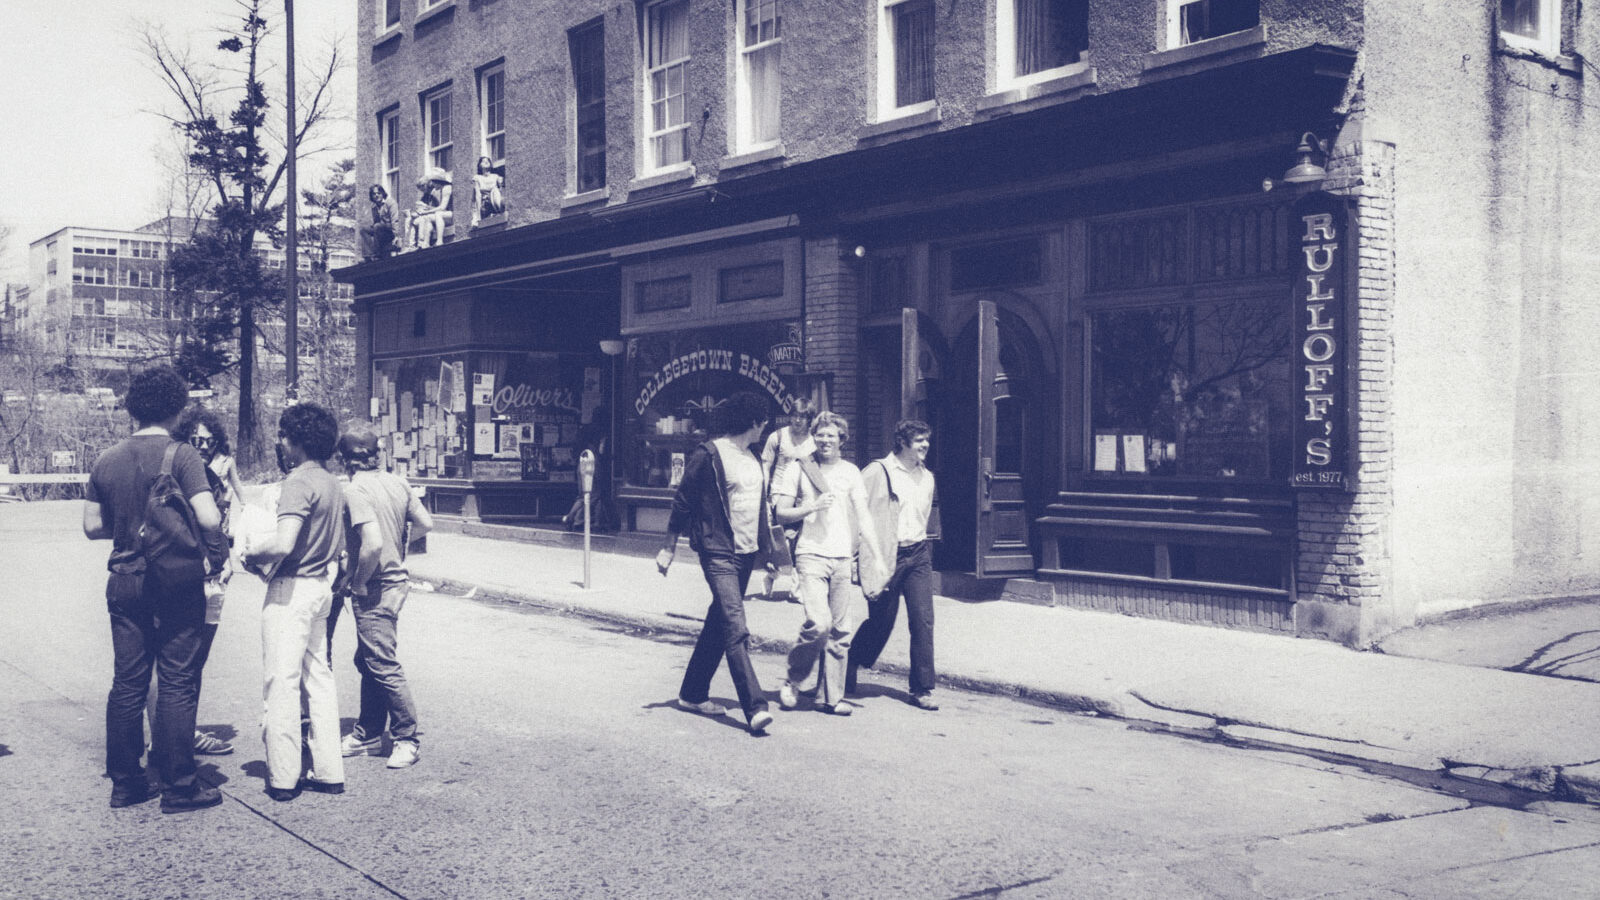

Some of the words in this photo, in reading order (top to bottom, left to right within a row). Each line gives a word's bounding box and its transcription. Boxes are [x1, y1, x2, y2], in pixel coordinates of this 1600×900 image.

[1302, 213, 1338, 466] RULLOFF'S
[493, 383, 580, 413] Oliver's
[635, 349, 734, 416] COLLEGETOWN
[738, 353, 795, 415] BAGELS
[1317, 471, 1342, 483] 1977
